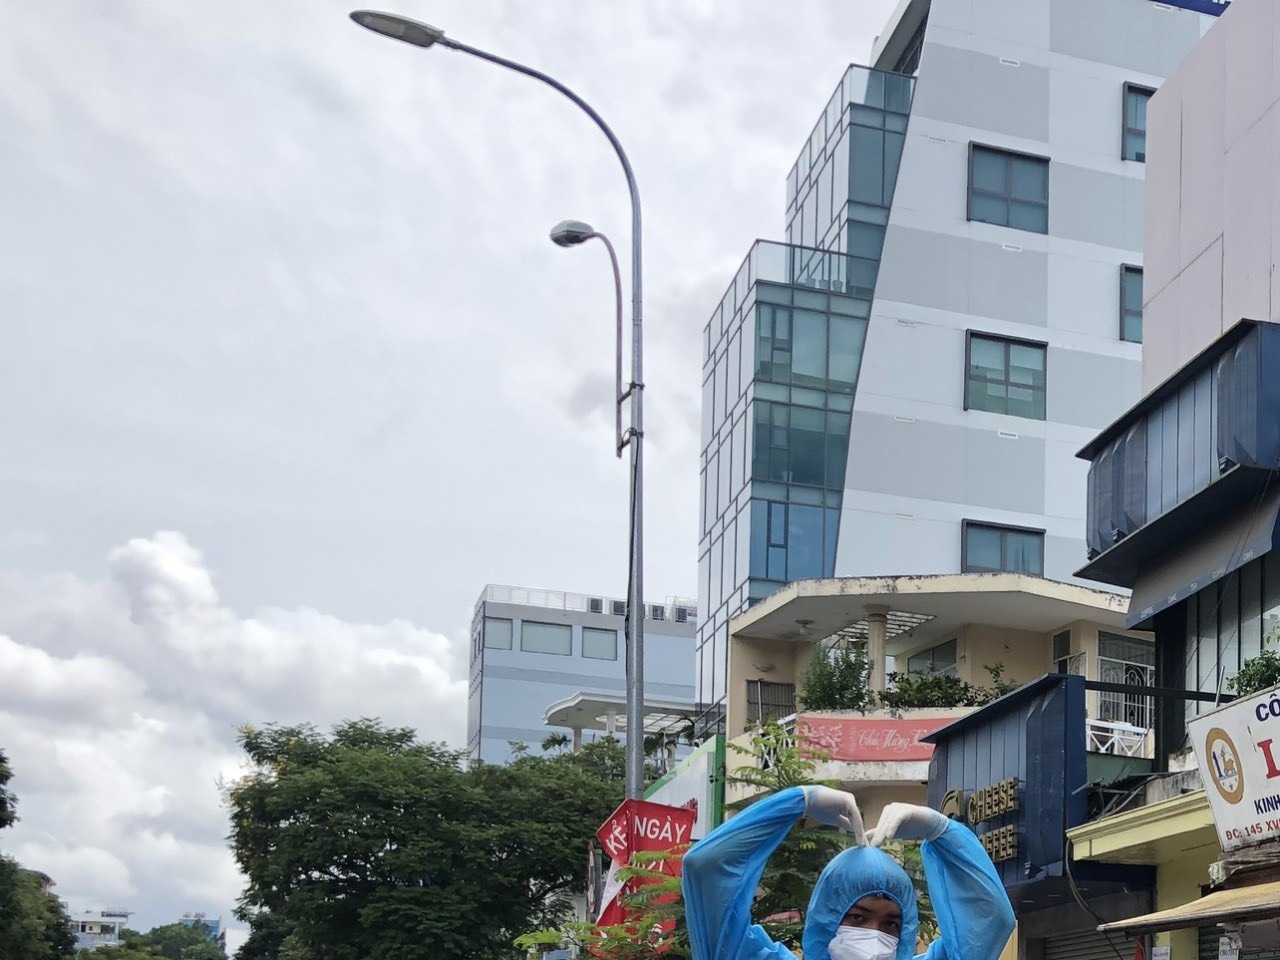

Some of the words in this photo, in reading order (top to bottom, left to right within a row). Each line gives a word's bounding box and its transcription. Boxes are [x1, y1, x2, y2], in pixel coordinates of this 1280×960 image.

[968, 777, 1019, 826] CHEESE
[634, 815, 687, 844] NGÀY
[1225, 829, 1243, 841] ĐC:
[1244, 823, 1263, 838] 145
